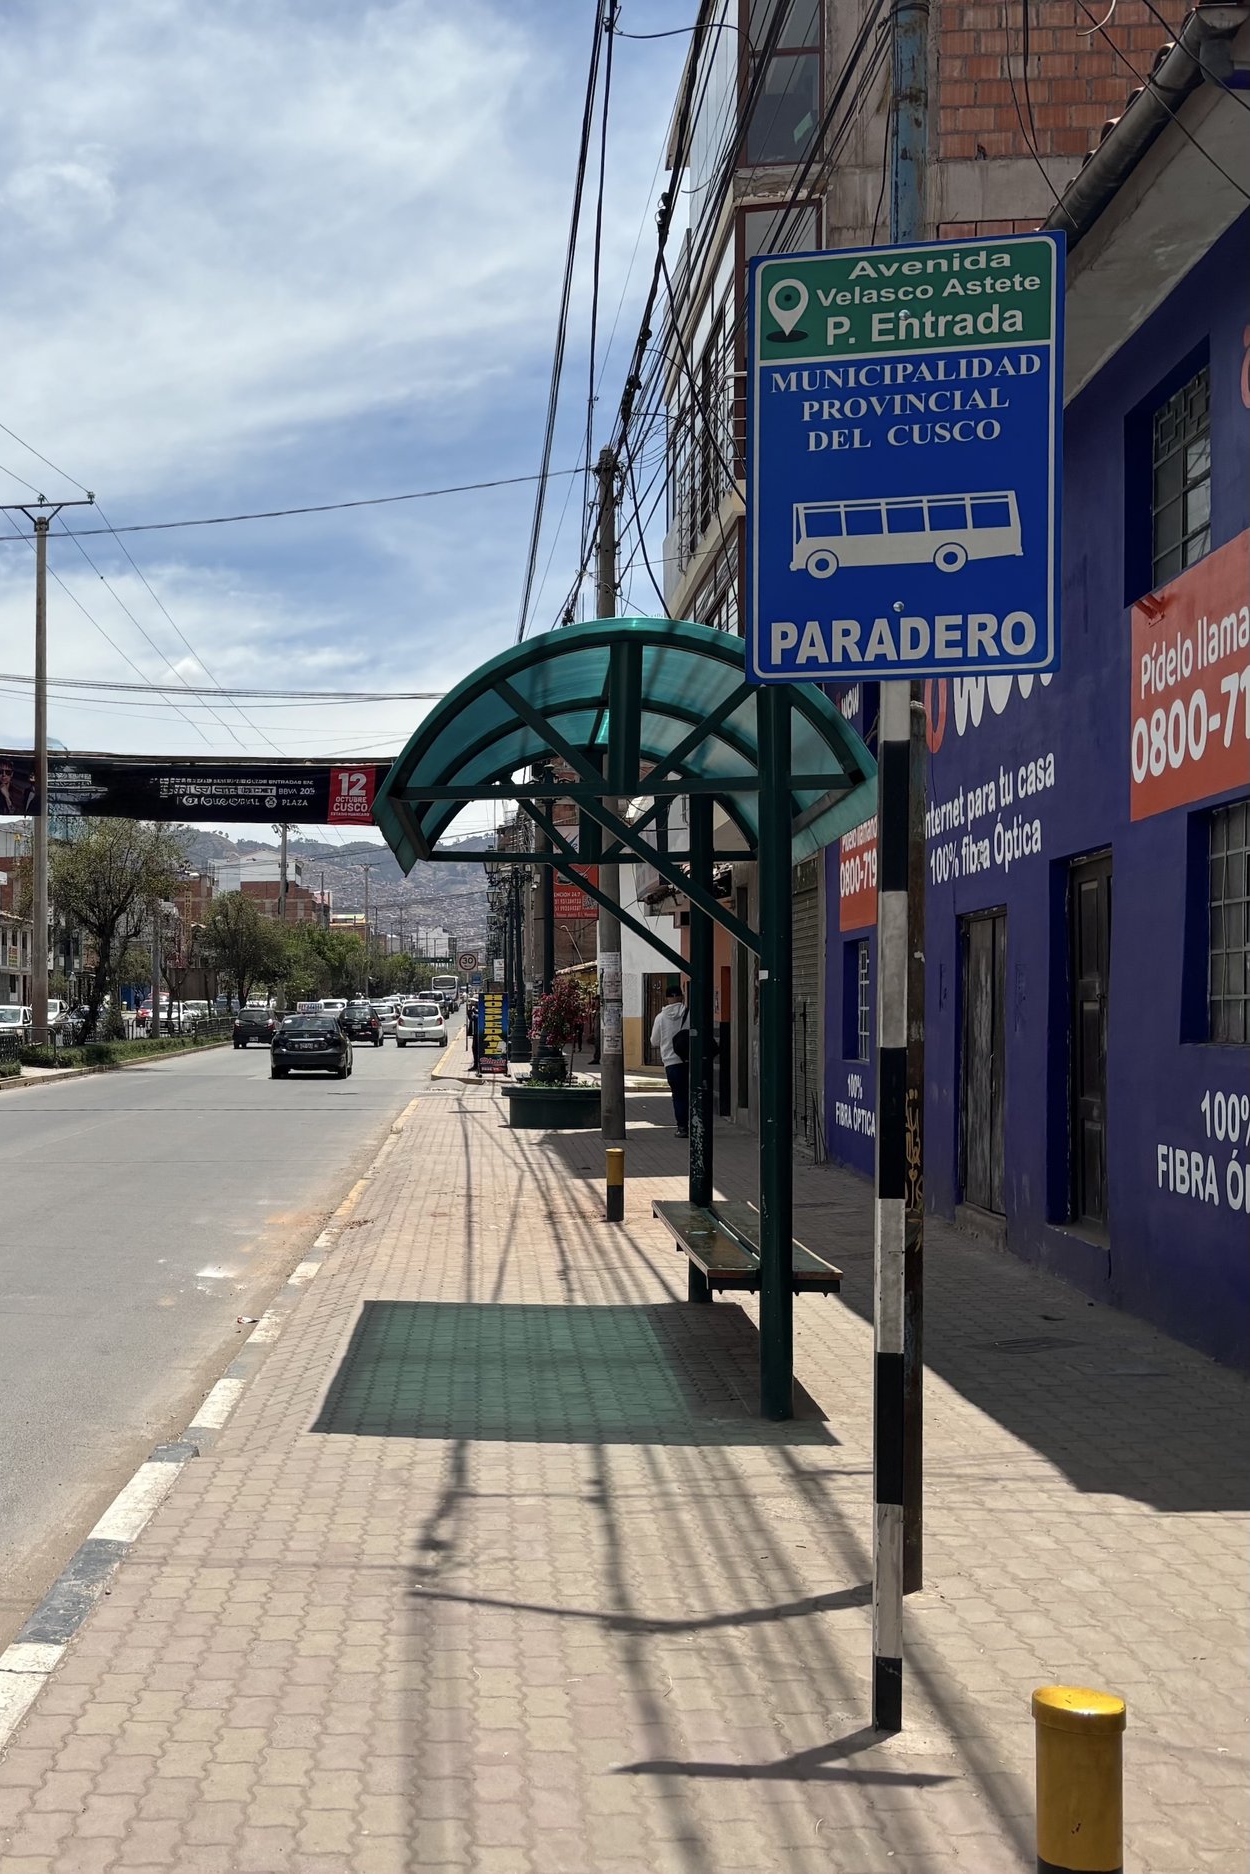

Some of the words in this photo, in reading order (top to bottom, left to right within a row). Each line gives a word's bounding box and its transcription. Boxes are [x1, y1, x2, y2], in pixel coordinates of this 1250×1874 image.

[848, 250, 1011, 280] Avenida
[816, 284, 934, 307] Velasco
[941, 273, 1042, 298] Astete
[826, 316, 856, 346] P.
[871, 303, 1024, 343] Entrada
[770, 353, 1042, 394] MUNICIPALIDAD
[801, 387, 1010, 422] PROVINCIAL
[806, 428, 872, 452] DEL
[887, 418, 1001, 447] CUSCO
[770, 610, 1037, 665] PARADERO
[1140, 631, 1193, 700] Pídelo
[1131, 663, 1250, 784] 0800-71
[278, 787, 297, 795] BBVA
[338, 772, 367, 796] 12
[924, 785, 965, 840] nternet
[967, 780, 996, 831] para
[999, 765, 1014, 807] tu
[1017, 752, 1055, 799] casa
[333, 802, 368, 812] CUSCO
[930, 840, 960, 886] 100%
[961, 835, 991, 877] fibra
[993, 812, 1042, 874] Óptica
[839, 847, 878, 898] 0800-719
[461, 957, 473, 965] 30
[847, 1073, 863, 1100] 100%
[835, 1101, 853, 1130] FIBRA
[853, 1101, 876, 1138] ÓPTICA
[1157, 1143, 1220, 1207] FIBRA
